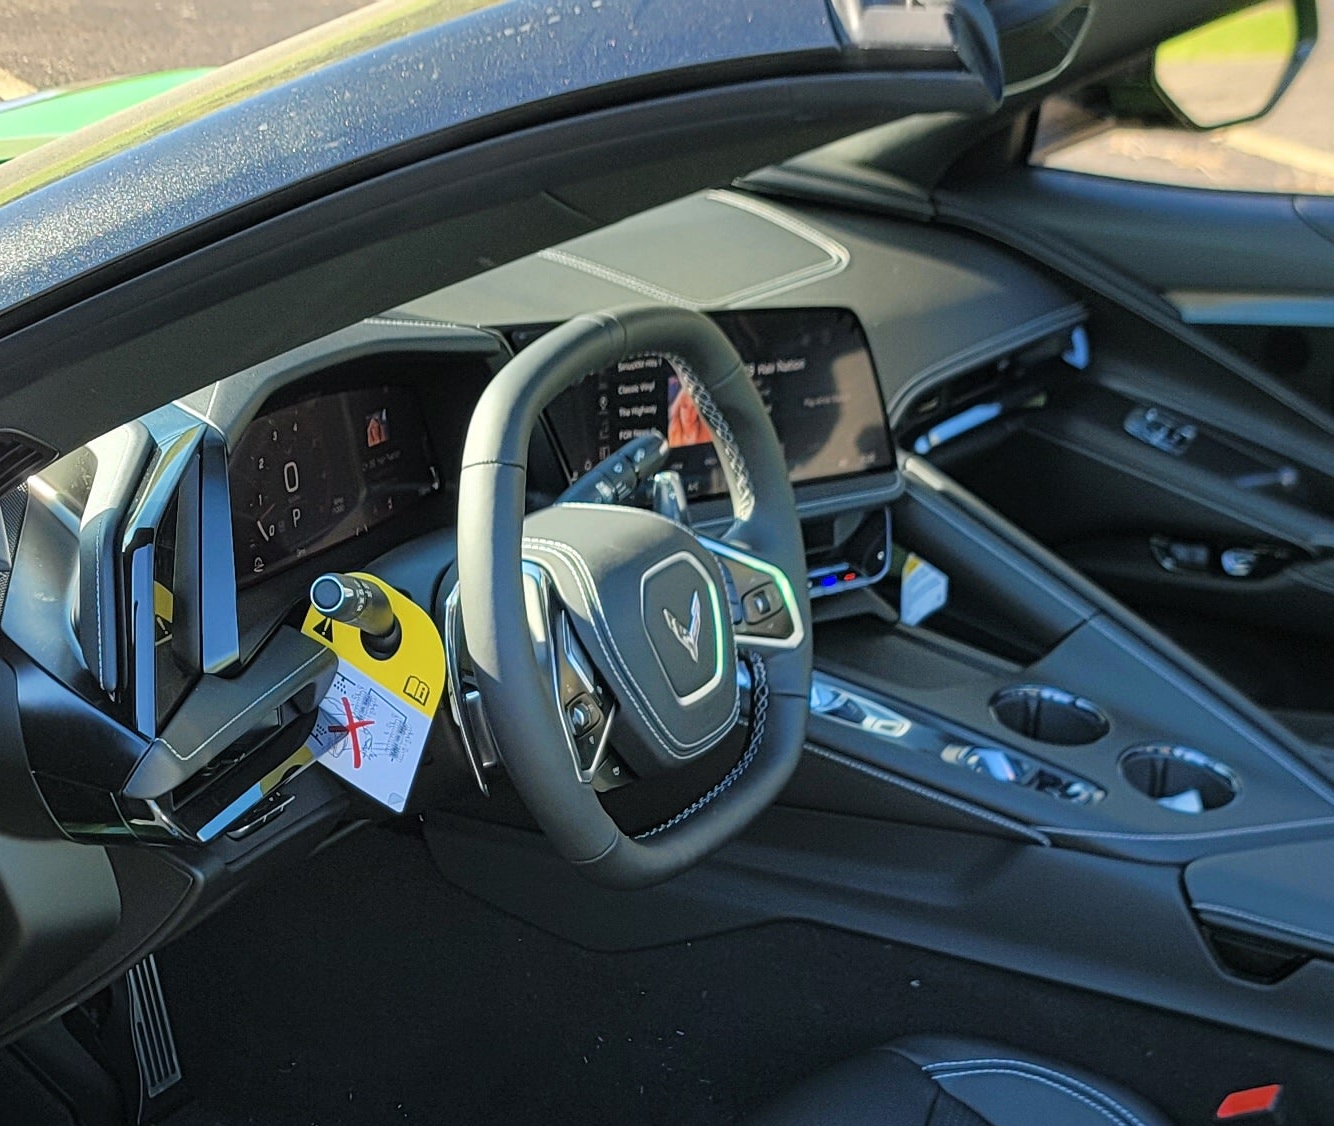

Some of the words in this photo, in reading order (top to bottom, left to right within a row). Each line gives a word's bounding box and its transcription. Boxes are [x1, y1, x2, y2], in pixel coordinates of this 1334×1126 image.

[776, 358, 806, 373] Nation
[619, 407, 631, 418] The
[631, 404, 658, 418] Highway
[293, 422, 298, 432] 4
[272, 430, 278, 442] 3
[258, 457, 265, 470] 2
[284, 461, 299, 493] 0
[293, 508, 301, 528] P
